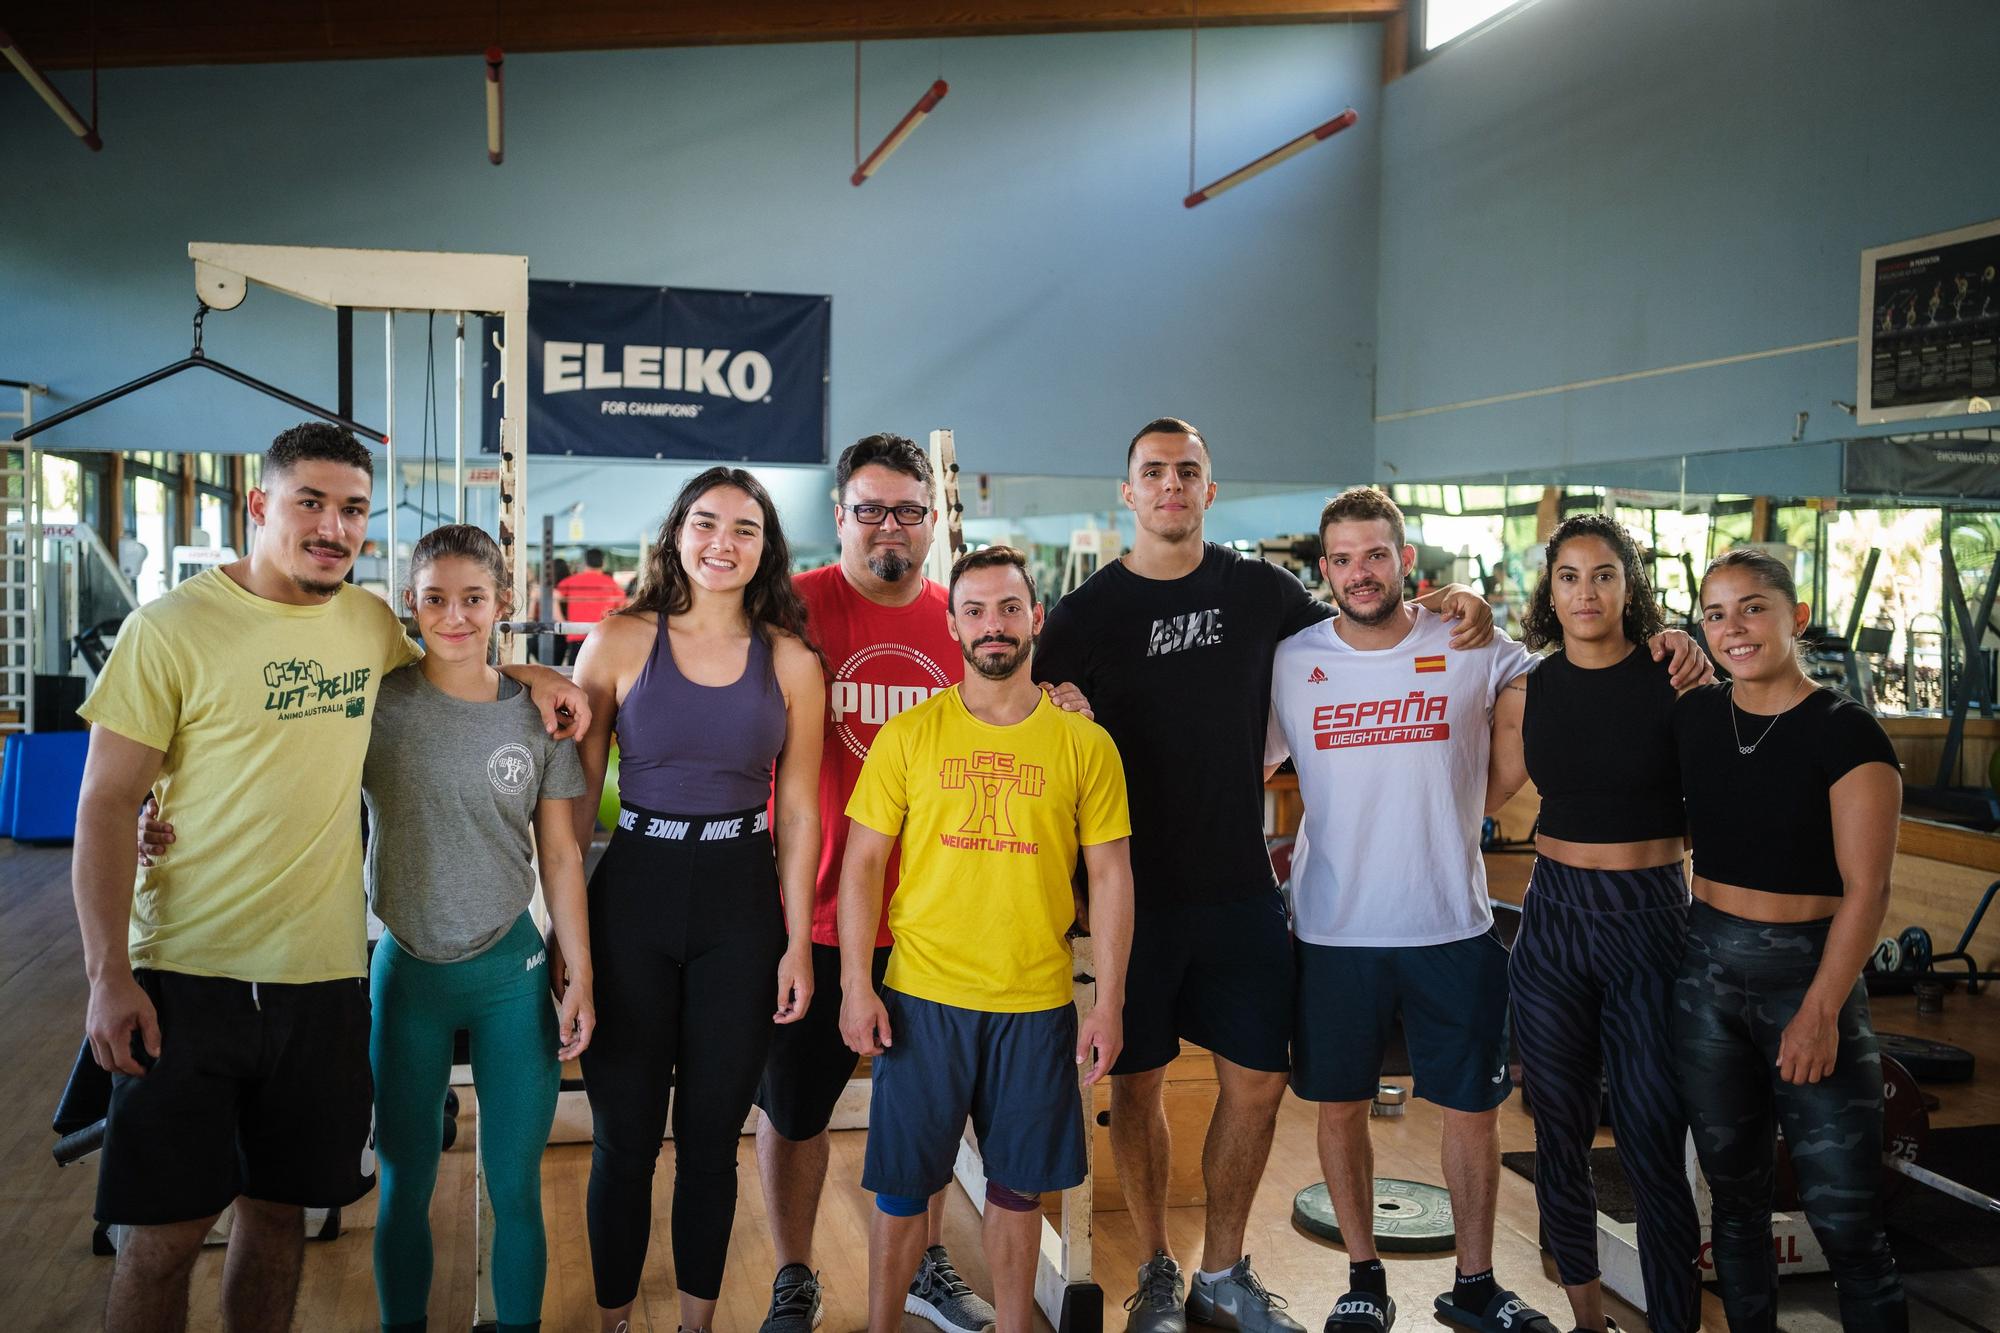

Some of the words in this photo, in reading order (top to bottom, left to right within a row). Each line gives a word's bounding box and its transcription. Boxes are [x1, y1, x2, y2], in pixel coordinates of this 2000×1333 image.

[544, 340, 773, 403] ELEIKO
[601, 401, 627, 415] FOR
[265, 685, 309, 710] LIFT
[317, 668, 371, 701] RELIEF
[304, 704, 344, 717] AUSTRALIA
[831, 681, 947, 725] PUM
[1313, 691, 1449, 731] ESPAÑA
[1329, 727, 1434, 746] WEIGHTLIFTING
[700, 818, 744, 841] NIKE
[940, 834, 1039, 854] WEIGHTLIFTING
